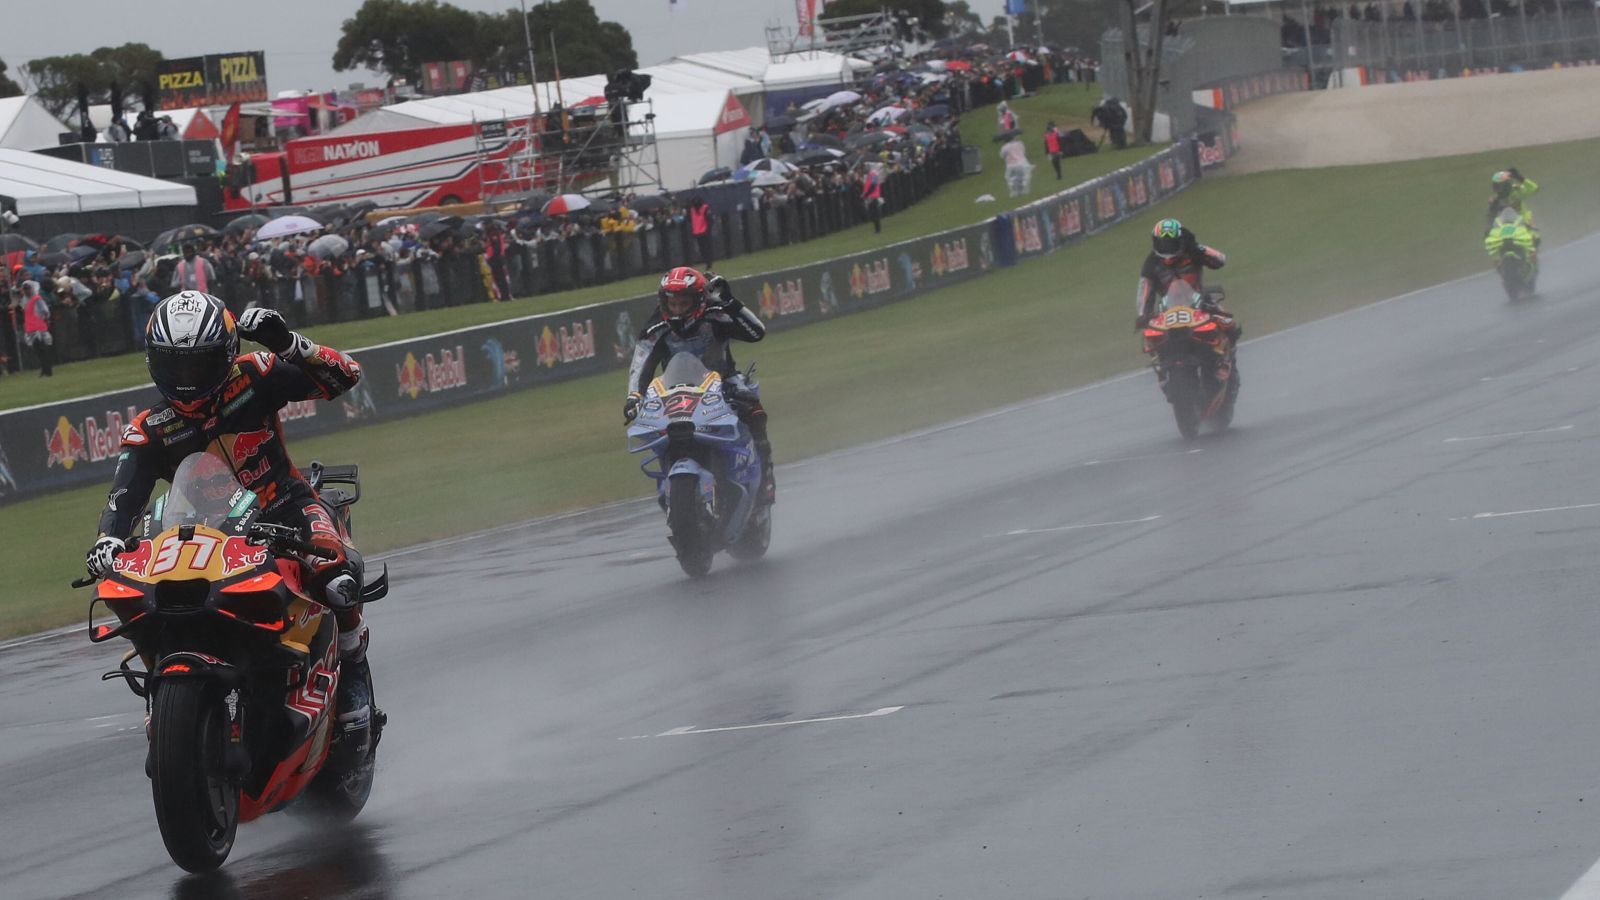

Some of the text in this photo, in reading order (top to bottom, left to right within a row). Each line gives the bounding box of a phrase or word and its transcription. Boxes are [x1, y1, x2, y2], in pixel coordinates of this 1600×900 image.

[159, 71, 204, 90] PIZZA
[220, 56, 257, 84] PIZZA
[323, 140, 380, 161] NATION
[1166, 310, 1191, 326] 33
[238, 456, 272, 486] Bull
[150, 533, 223, 577] 37
